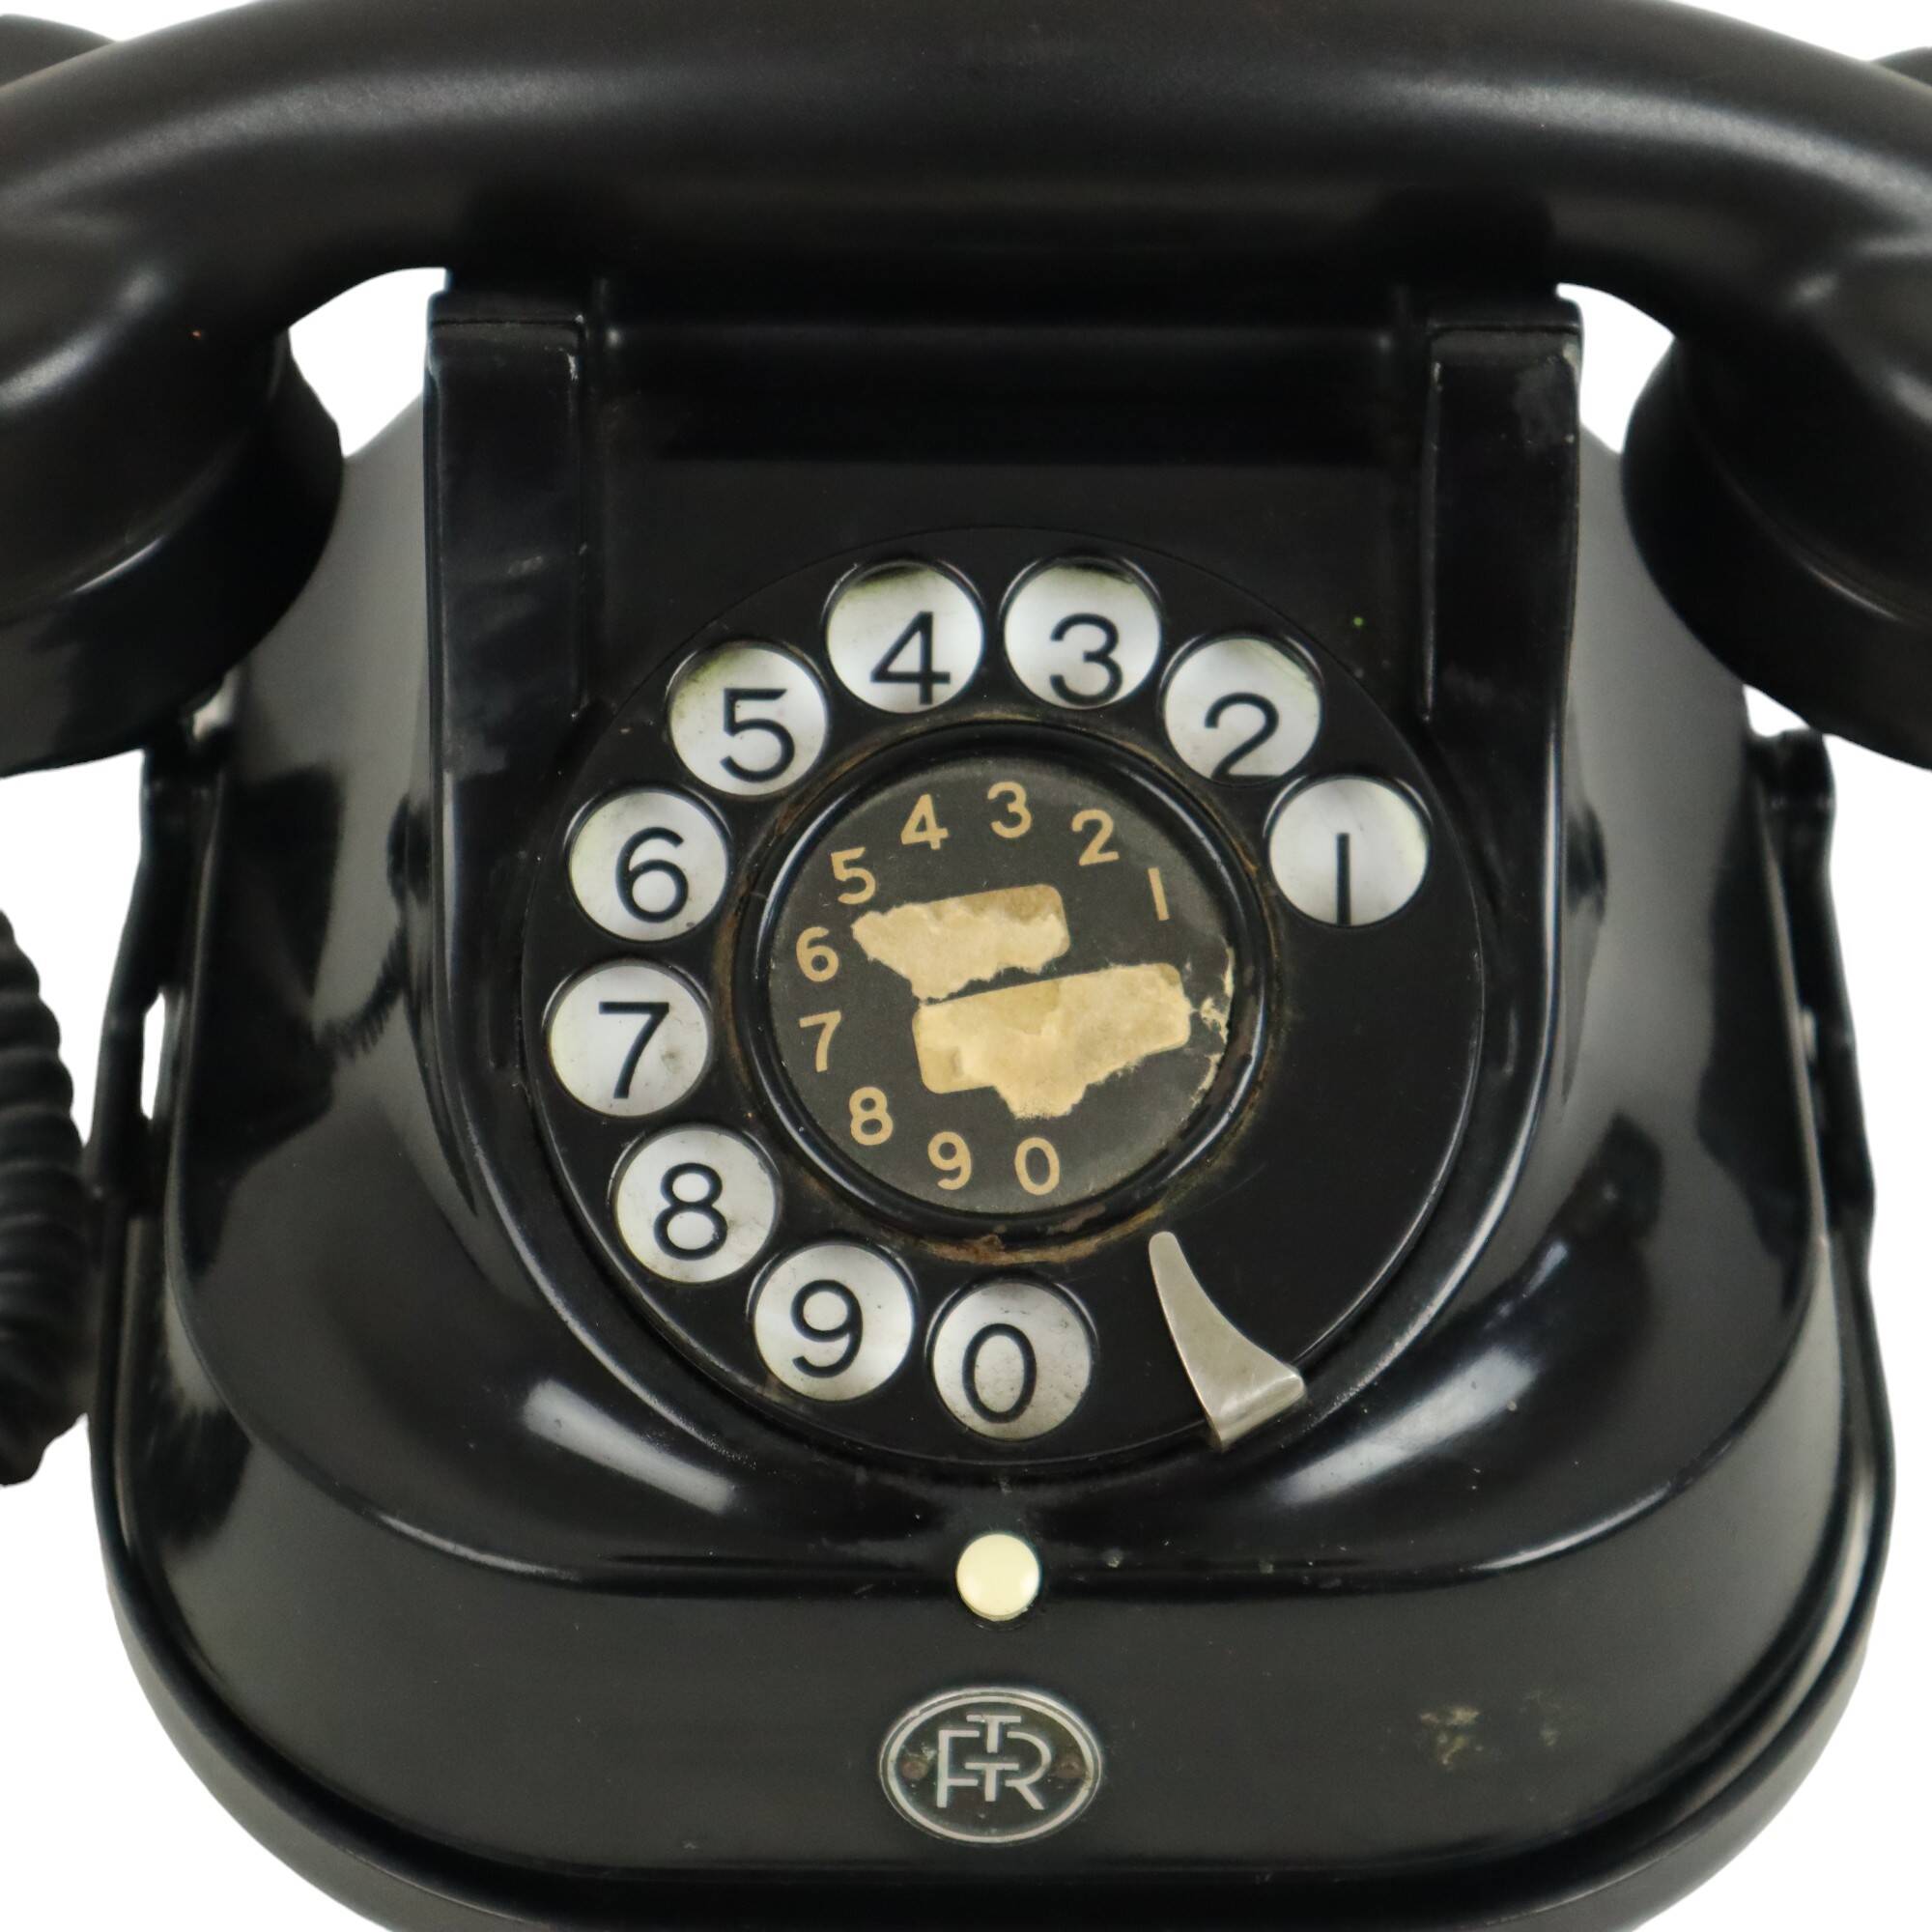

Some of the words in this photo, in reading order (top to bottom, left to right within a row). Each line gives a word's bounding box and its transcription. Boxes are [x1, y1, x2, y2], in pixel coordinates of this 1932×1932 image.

[870, 611, 952, 705] 4
[1050, 612, 1123, 706] 3
[720, 687, 796, 783] 5
[1205, 692, 1285, 781] 2
[901, 794, 949, 849] 4
[987, 781, 1032, 838] 3
[1072, 809, 1119, 866] 2
[618, 827, 688, 923] 6
[831, 847, 875, 904] 5
[1149, 867, 1169, 921] 1
[1336, 833, 1351, 925] 1
[796, 926, 838, 981] 6
[599, 1001, 670, 1099] 7
[800, 1010, 841, 1072] 7
[849, 1087, 894, 1146] 8
[928, 1131, 972, 1190] 9
[1014, 1137, 1061, 1196] 0
[655, 1163, 727, 1260] 8
[793, 1280, 863, 1378] 9
[963, 1323, 1037, 1424] 0
